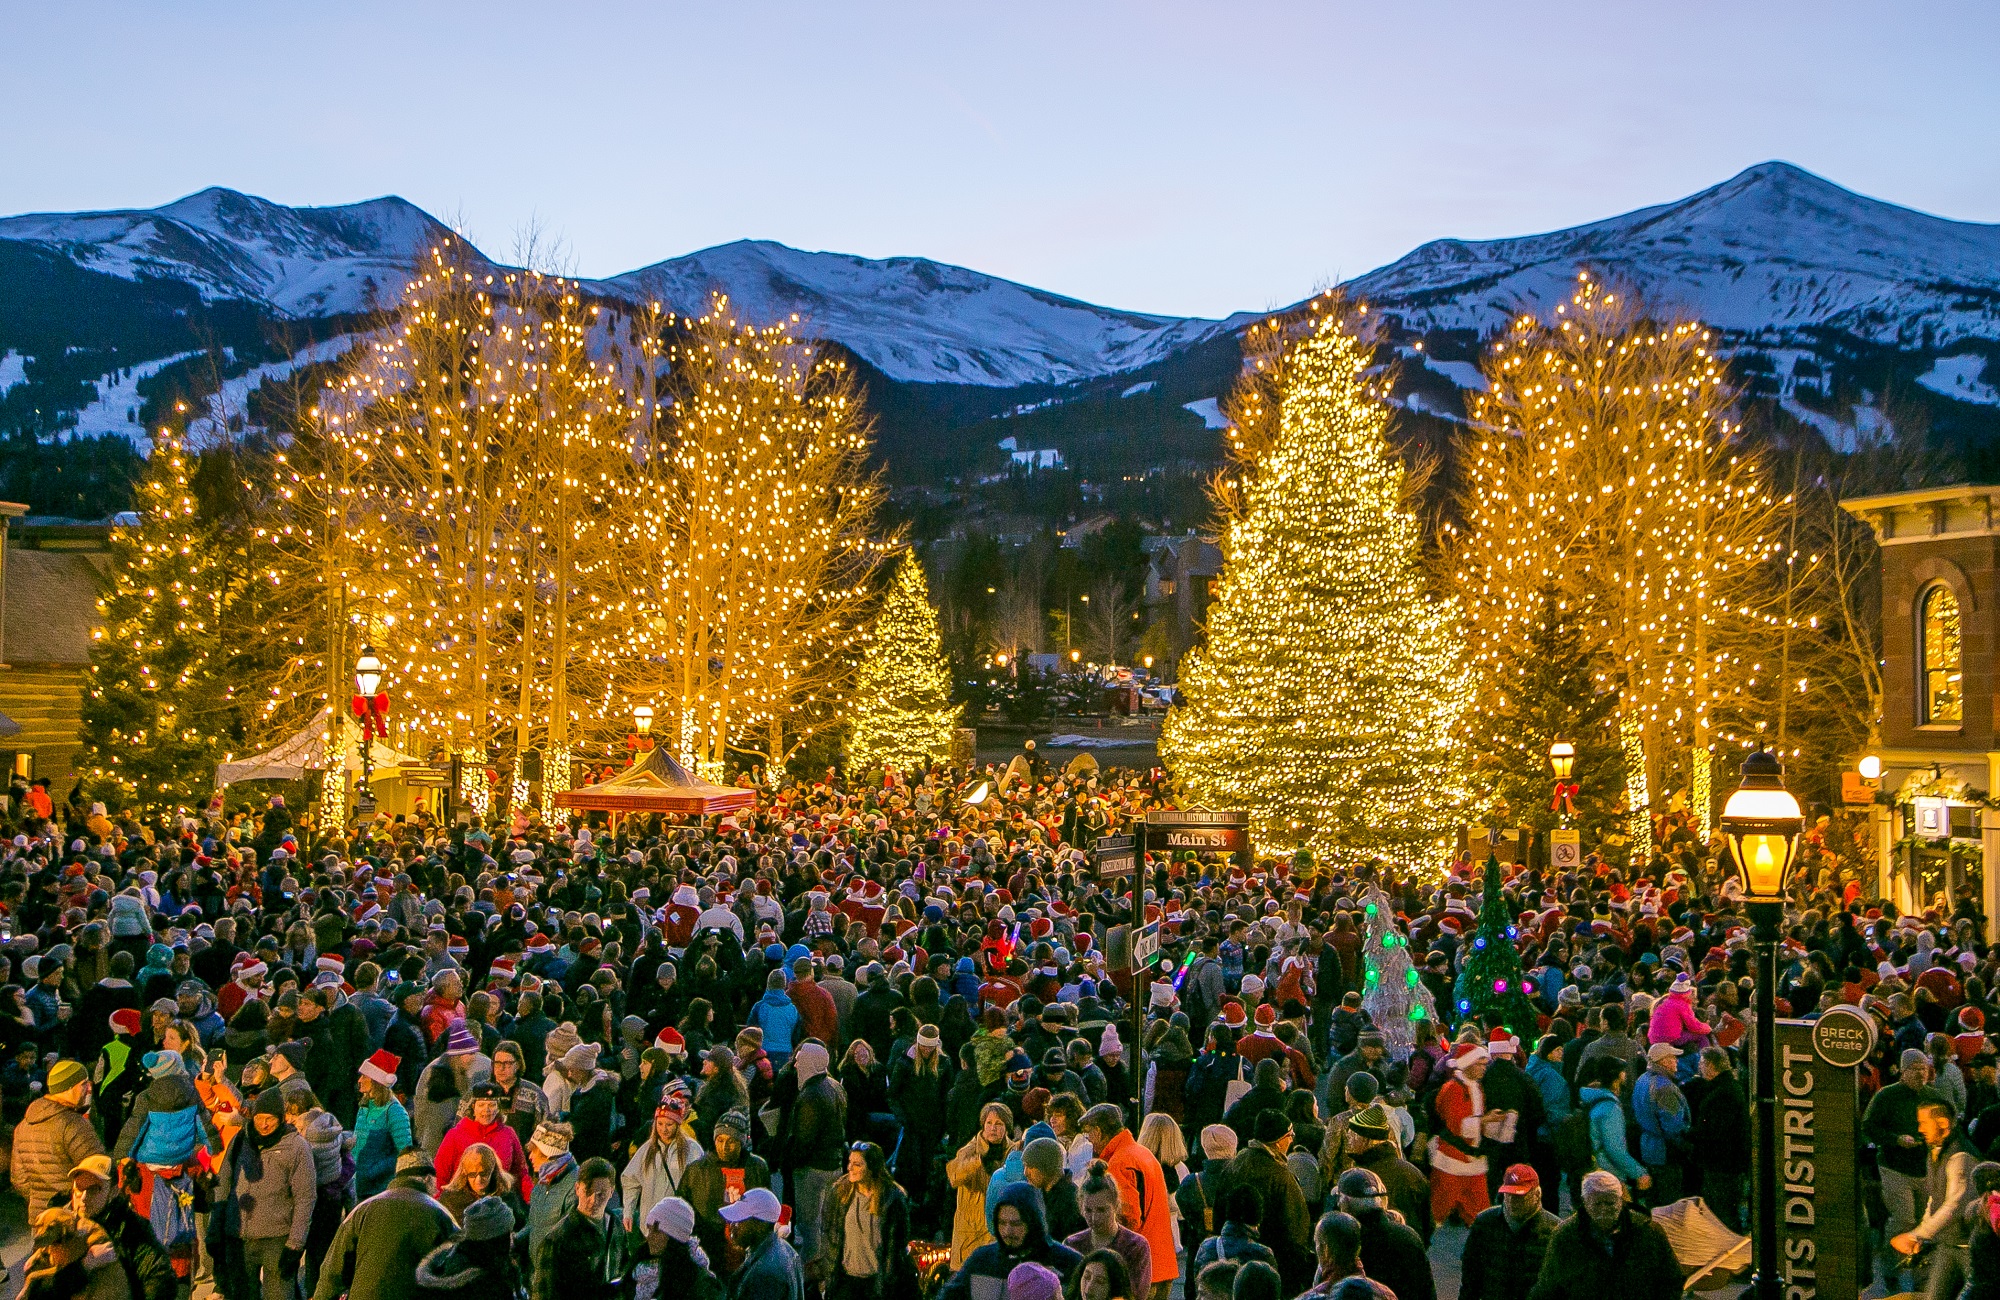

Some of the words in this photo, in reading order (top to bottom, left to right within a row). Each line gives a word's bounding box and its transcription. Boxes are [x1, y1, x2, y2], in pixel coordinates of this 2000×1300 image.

[1186, 813, 1212, 822] HISTORIC
[1212, 813, 1238, 822] DISTRICT
[1167, 833, 1206, 846] Main
[1210, 833, 1227, 847] St
[1820, 1028, 1864, 1040] BRECK
[1822, 1038, 1863, 1051] Create
[1783, 1045, 1815, 1225] DISTRICT
[1785, 1238, 1816, 1300] RTS
